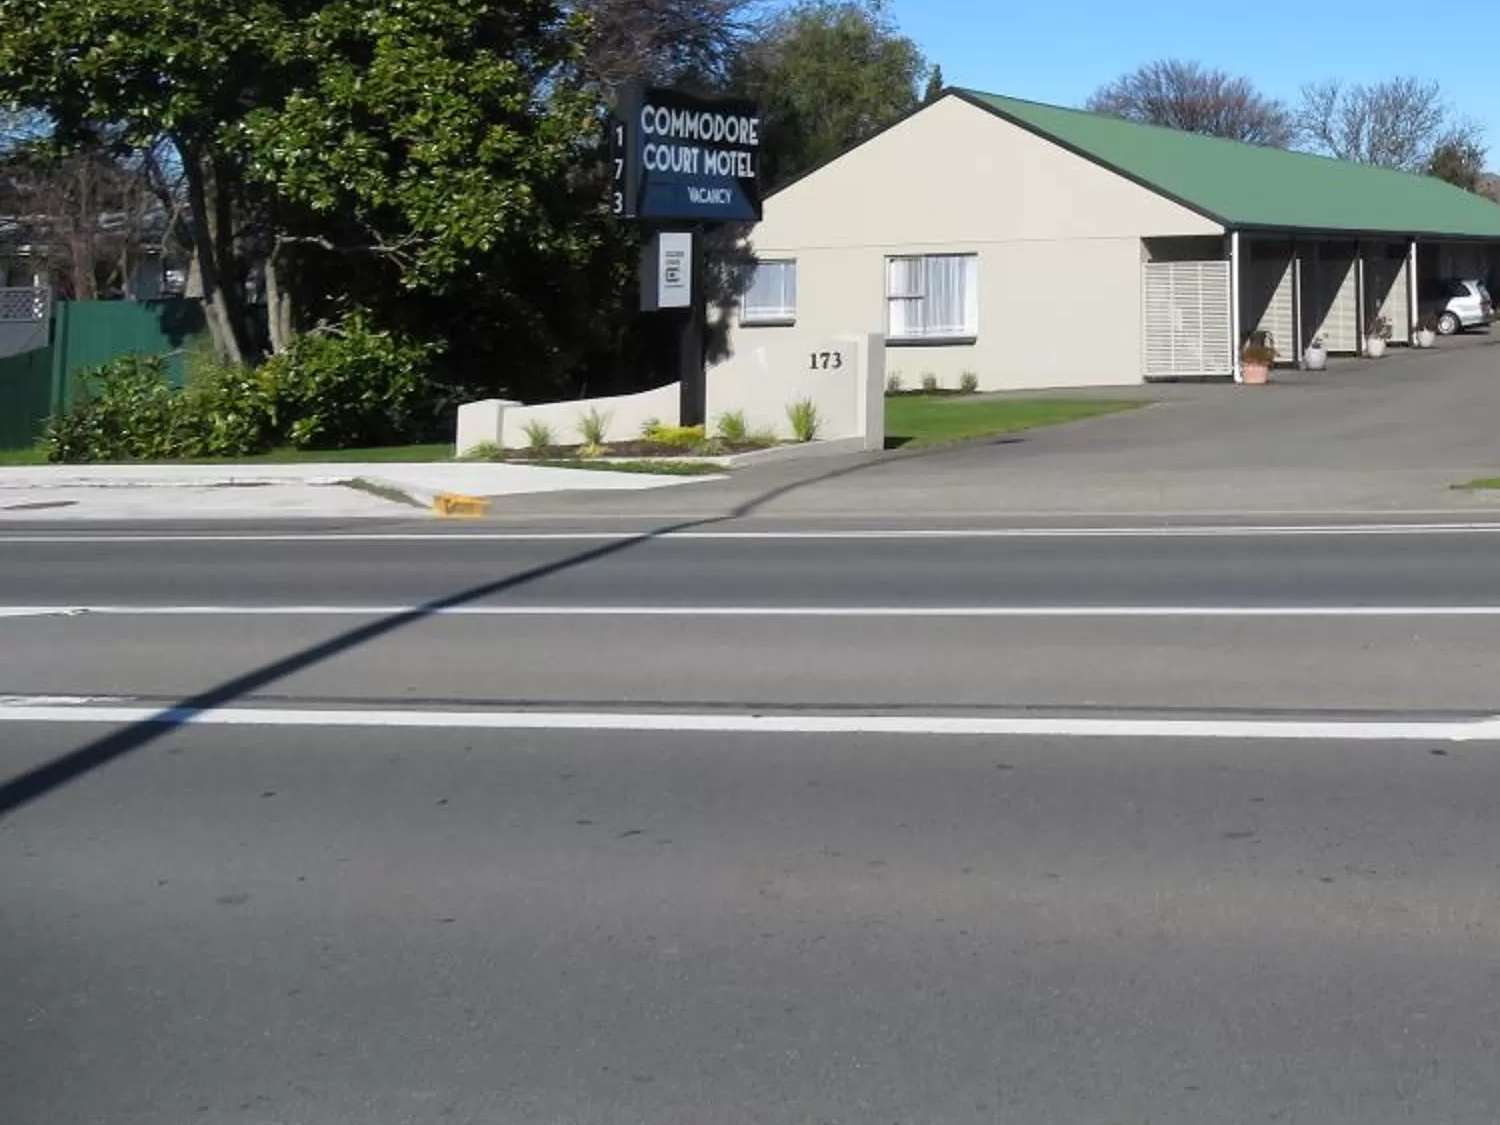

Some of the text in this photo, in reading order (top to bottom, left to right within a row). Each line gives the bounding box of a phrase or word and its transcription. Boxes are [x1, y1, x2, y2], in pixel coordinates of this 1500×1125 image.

[641, 104, 759, 145] COMMODORE
[643, 143, 755, 178] COURT MOTEL
[688, 186, 733, 204] VACANCY
[810, 352, 842, 370] 173
